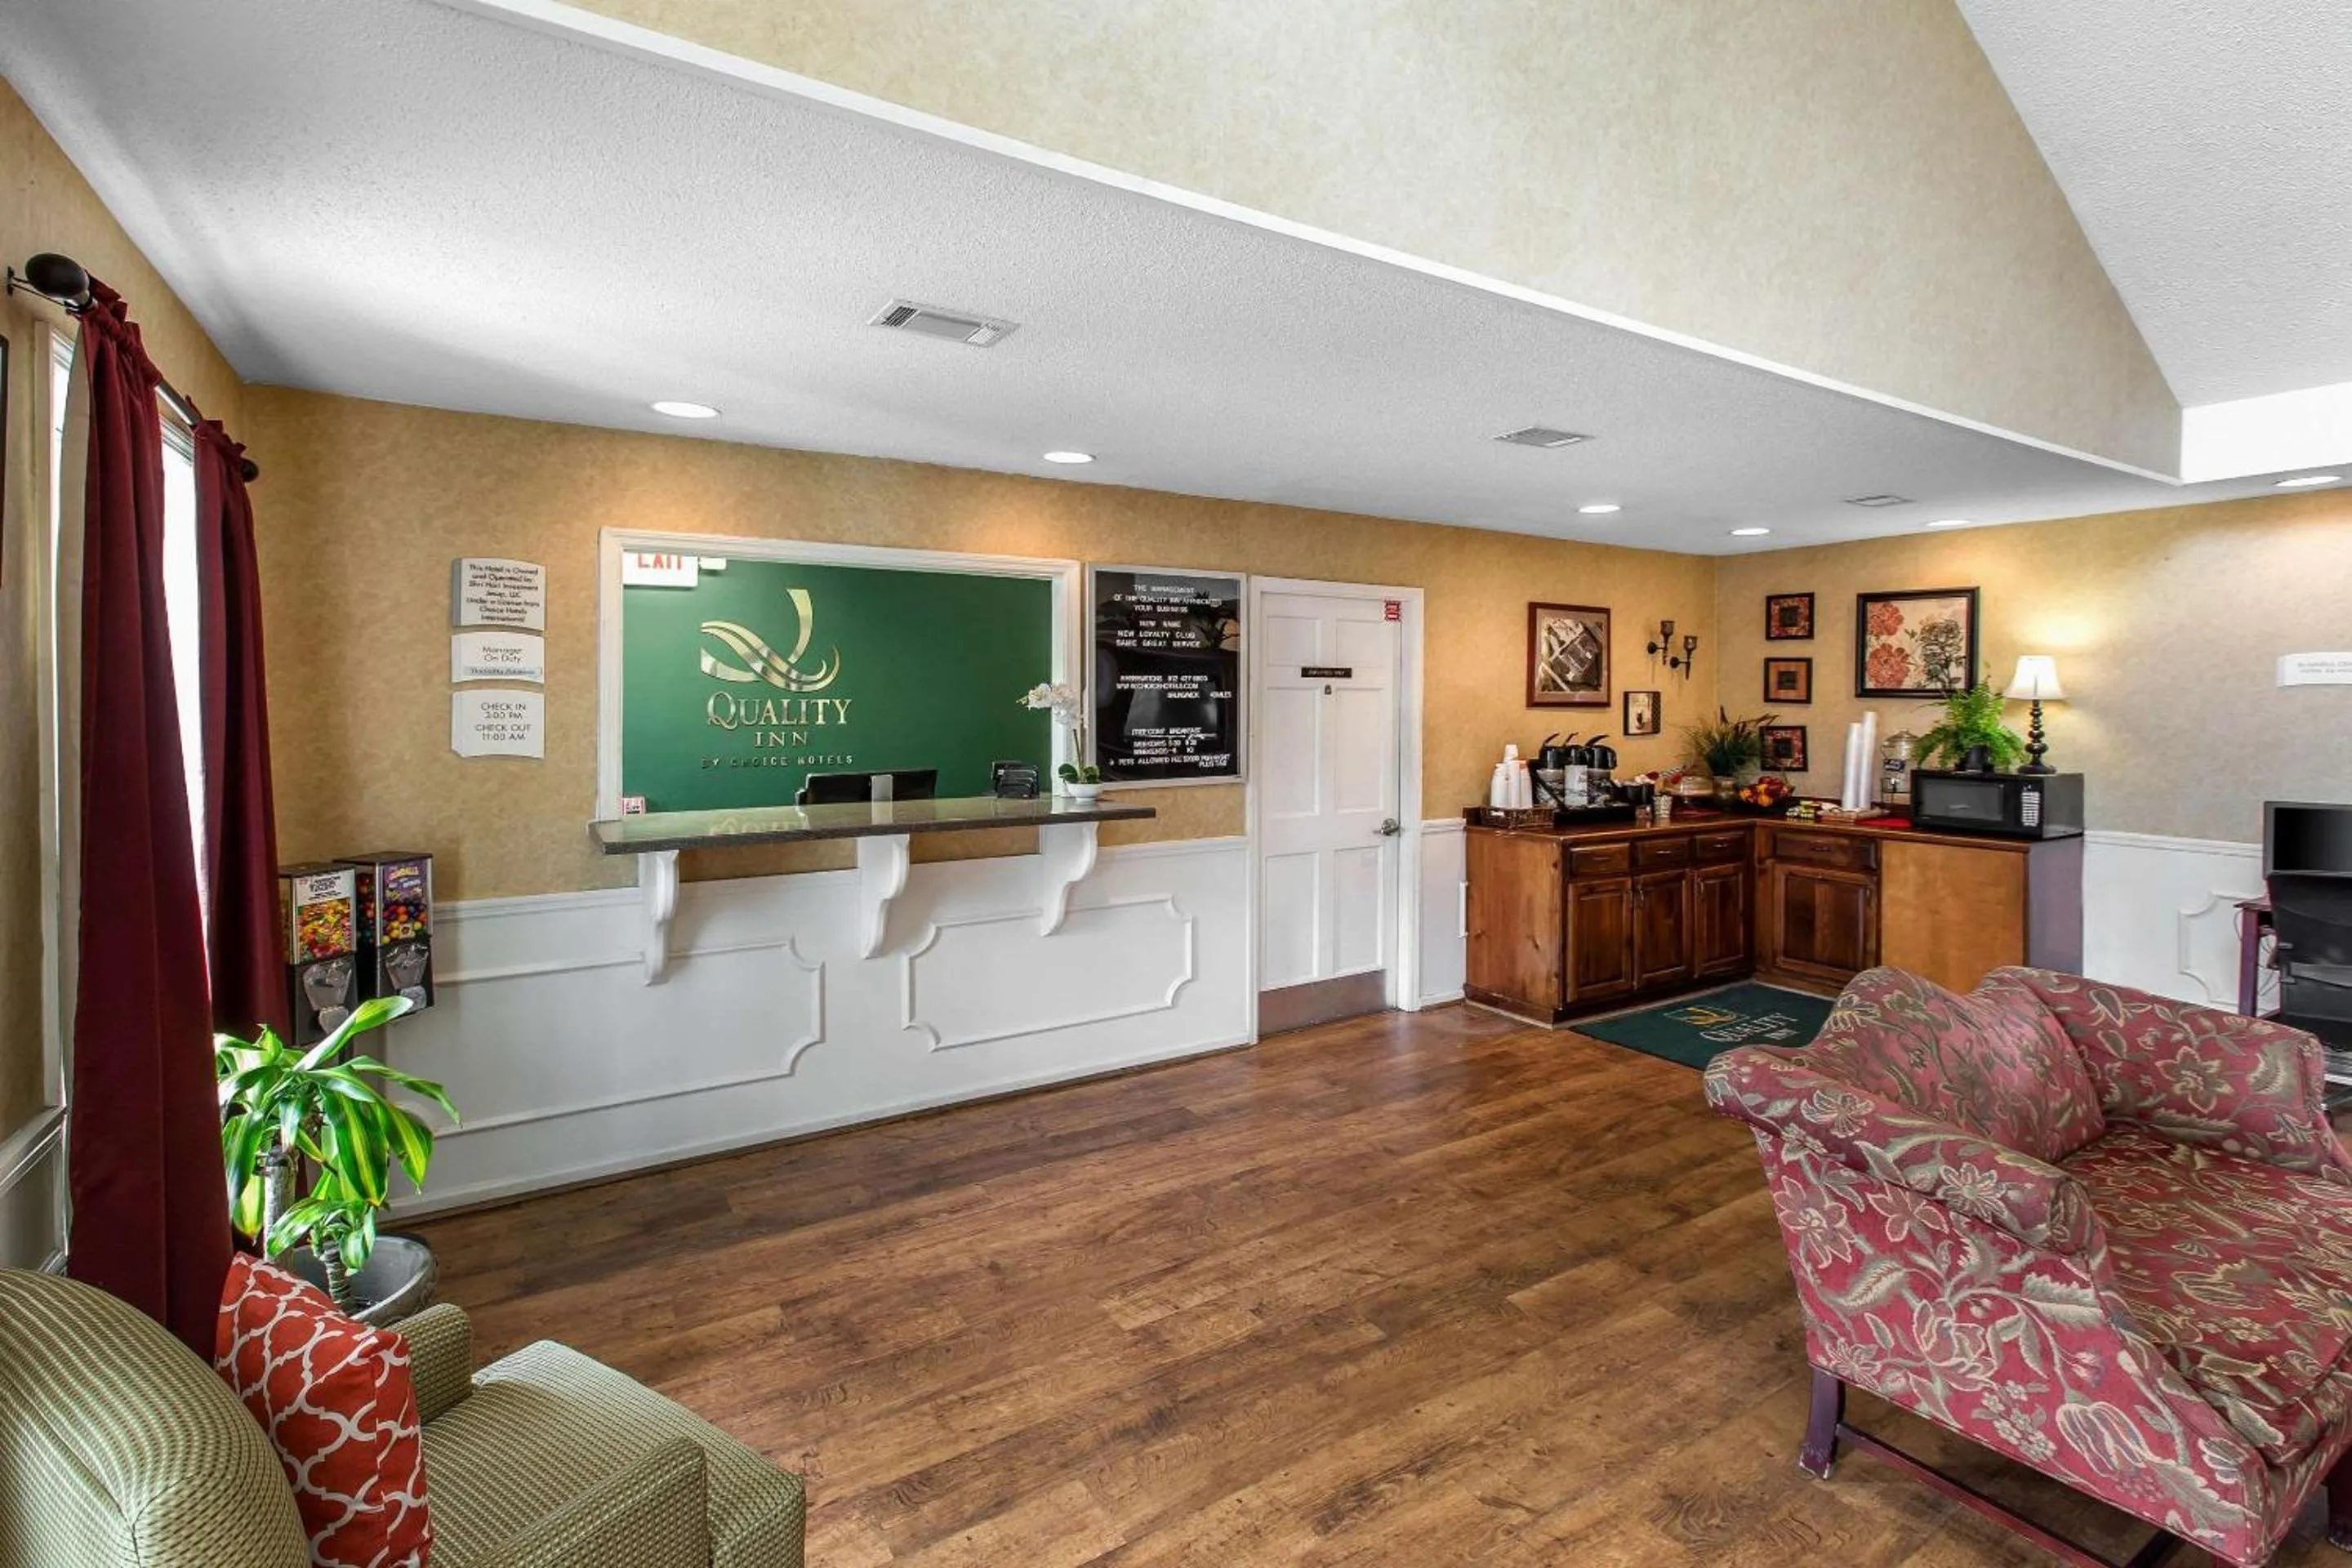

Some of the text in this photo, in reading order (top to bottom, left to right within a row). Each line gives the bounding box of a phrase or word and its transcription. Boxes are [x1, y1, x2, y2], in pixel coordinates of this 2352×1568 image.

[512, 567, 539, 575] Owned
[483, 653, 521, 663] On Duty
[480, 702, 513, 710] CHECK
[707, 691, 852, 729] QUALITY
[476, 724, 531, 732] CHECK OUT
[754, 731, 808, 748] INN
[731, 757, 788, 768] CHOICE
[797, 755, 853, 766] HOTELS
